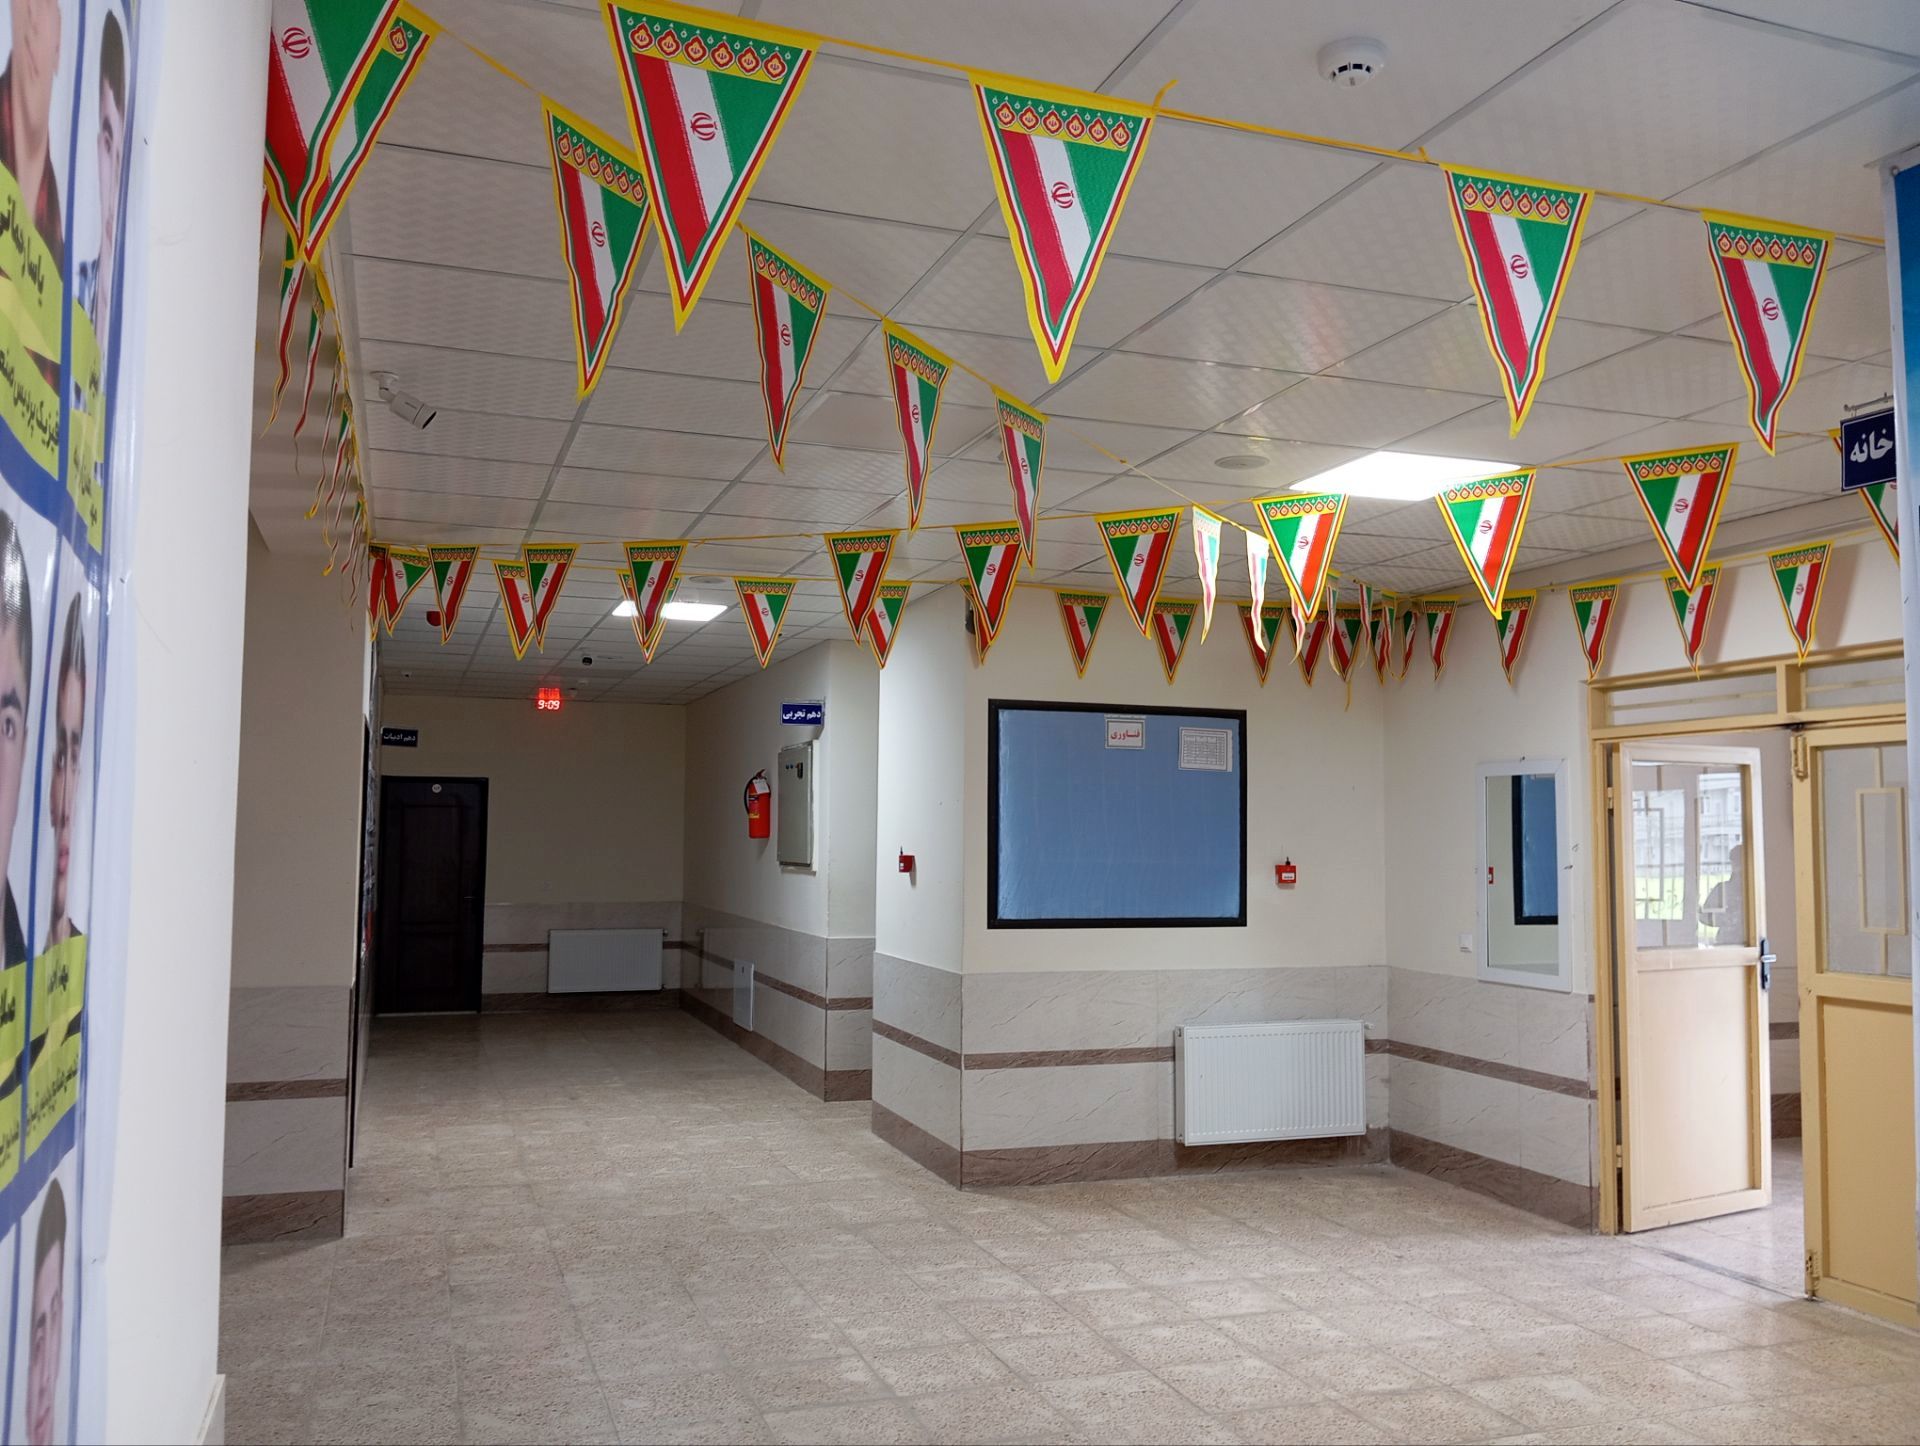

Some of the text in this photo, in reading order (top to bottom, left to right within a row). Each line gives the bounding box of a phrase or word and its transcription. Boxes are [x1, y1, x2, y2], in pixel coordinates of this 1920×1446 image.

[538, 700, 560, 710] 9:09
[782, 708, 822, 721] دهم تجربی
[403, 734, 416, 742] دهم
[1110, 727, 1141, 741] فناوری
